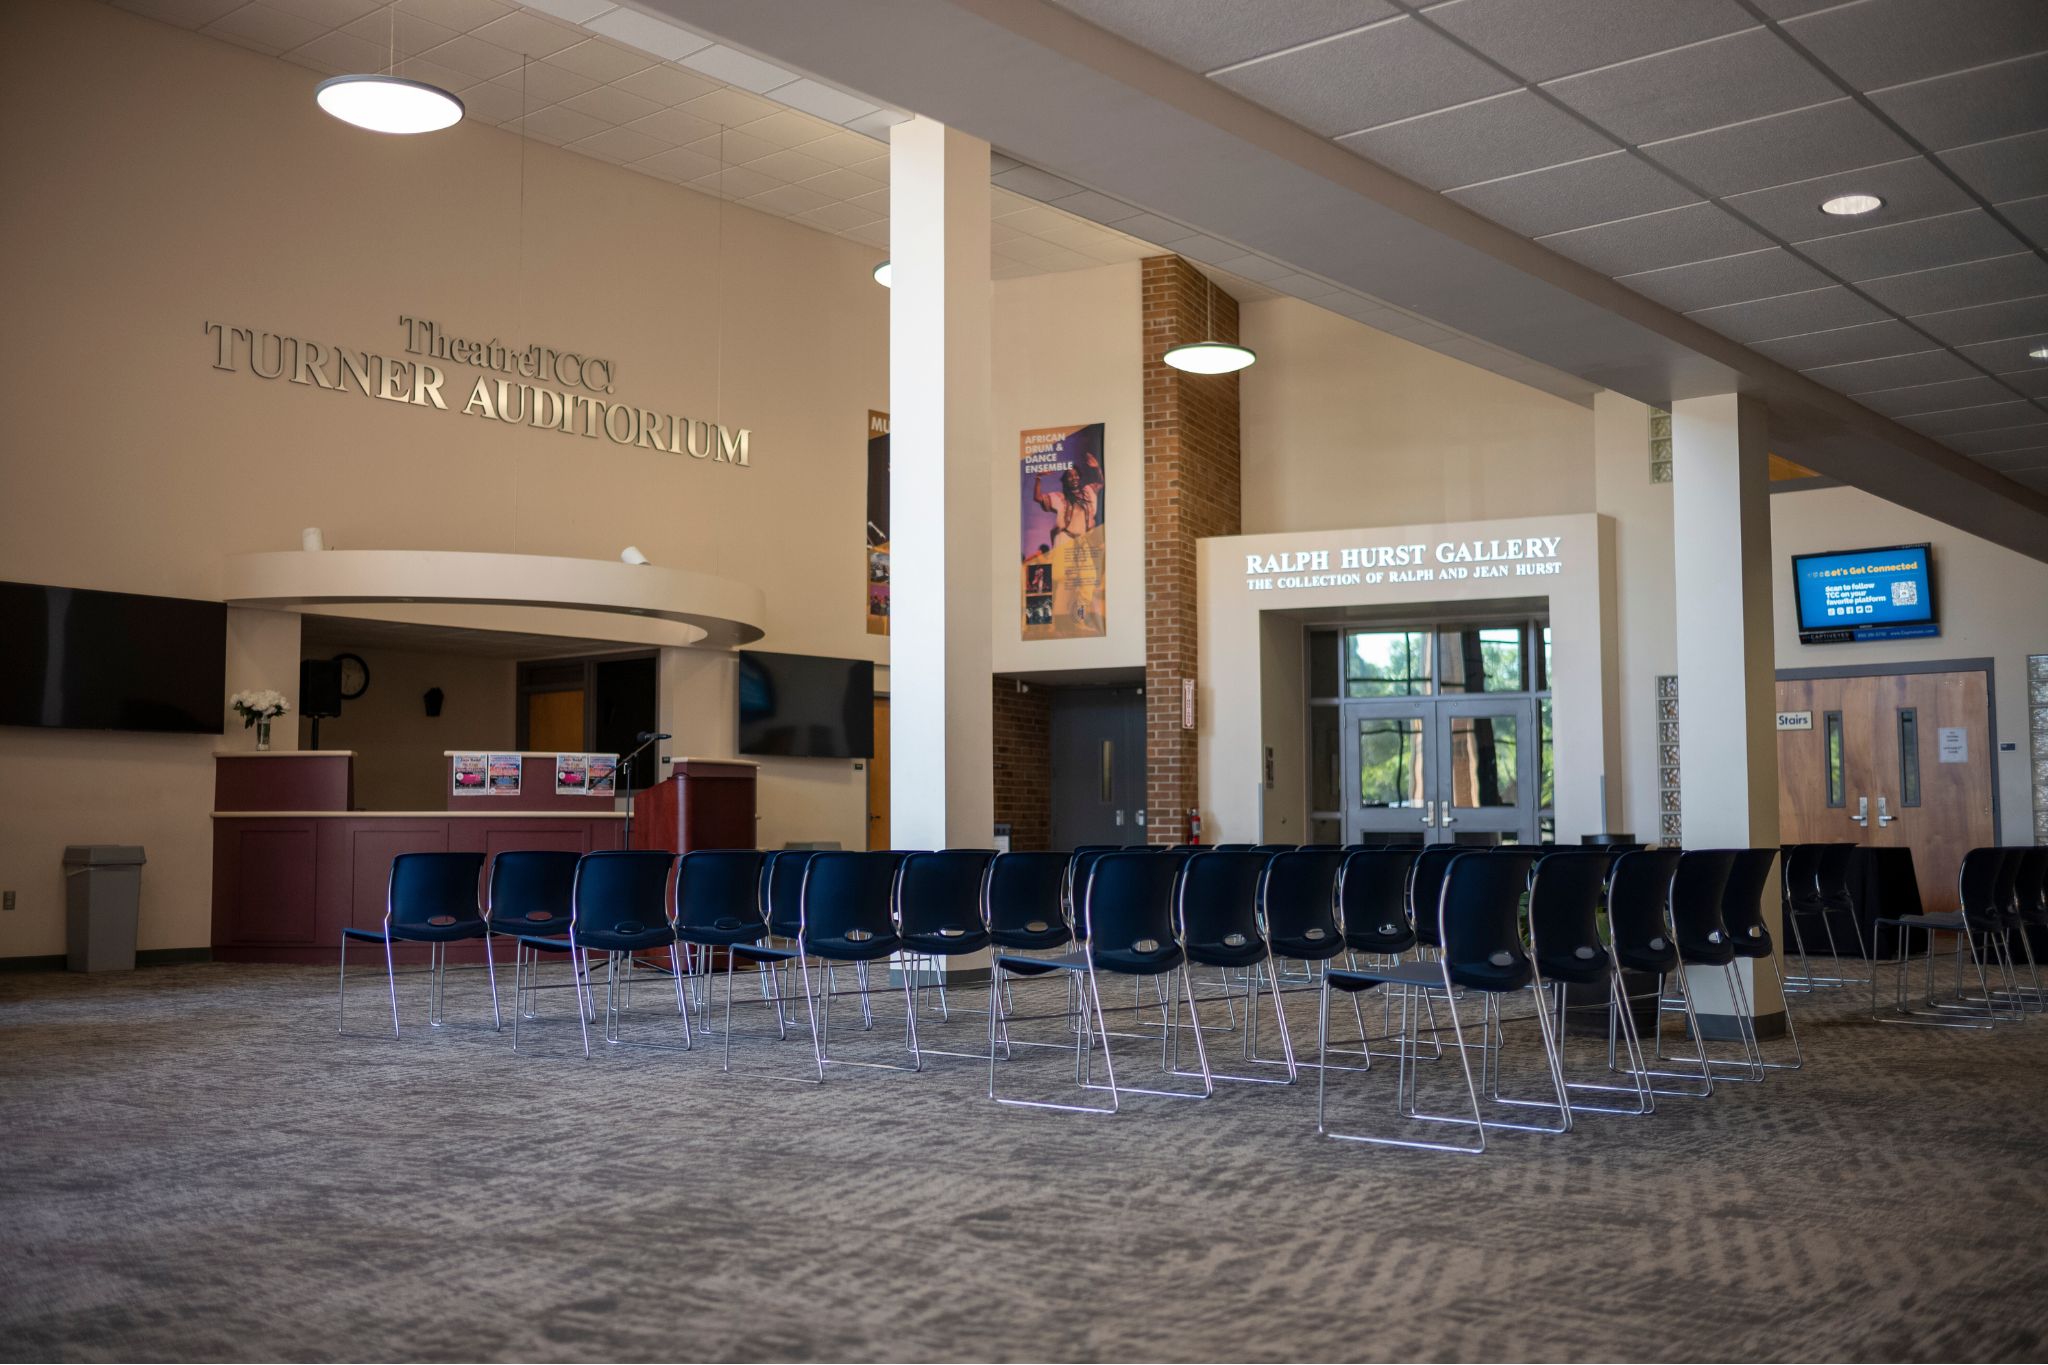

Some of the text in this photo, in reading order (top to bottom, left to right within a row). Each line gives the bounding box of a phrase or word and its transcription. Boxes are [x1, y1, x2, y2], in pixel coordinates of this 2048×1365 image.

[400, 315, 616, 394] TheatreTCC!
[205, 320, 752, 467] TURNER AUDITORIUM
[1025, 433, 1066, 444] AFRICAN
[1025, 442, 1063, 454] DRUM &
[1025, 453, 1057, 463] DANCE
[1025, 461, 1073, 474] ENSEMBLE
[1246, 537, 1561, 574] RALPH HURST GALLERY
[1850, 566, 1866, 575] Get
[1867, 561, 1918, 574] Connected
[1247, 562, 1562, 591] THE COLLECTION OF RALPH AND JEAN HURST
[1825, 581, 1875, 592] Scan to follow
[1826, 591, 1840, 599] TCC
[1850, 590, 1867, 598] your
[1826, 597, 1854, 606] favorite
[1854, 594, 1886, 605] platform
[1778, 714, 1809, 726] Stairs
